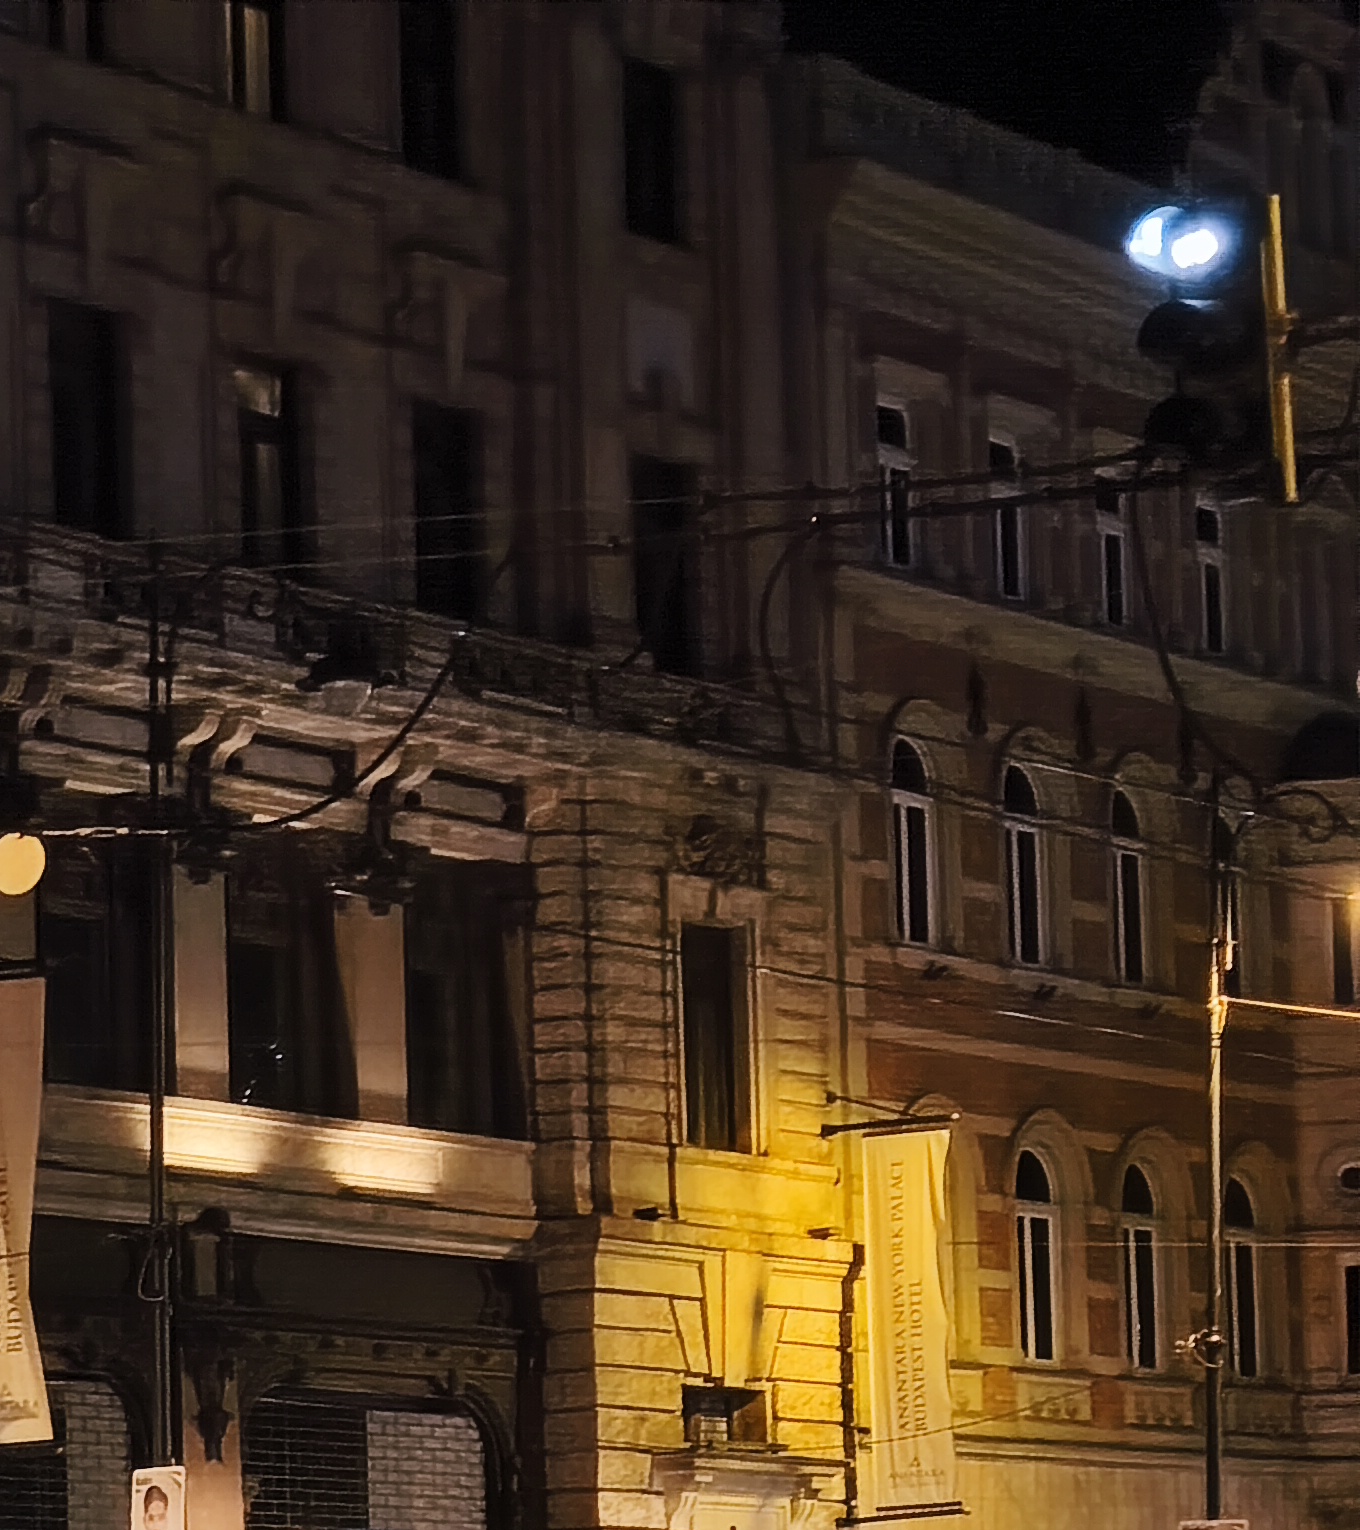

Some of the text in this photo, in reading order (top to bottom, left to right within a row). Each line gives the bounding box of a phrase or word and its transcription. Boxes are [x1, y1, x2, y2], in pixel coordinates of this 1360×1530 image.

[889, 1160, 912, 1432] ANANTARA NEW YORK PALACE
[911, 1346, 929, 1432] BUDAPEST
